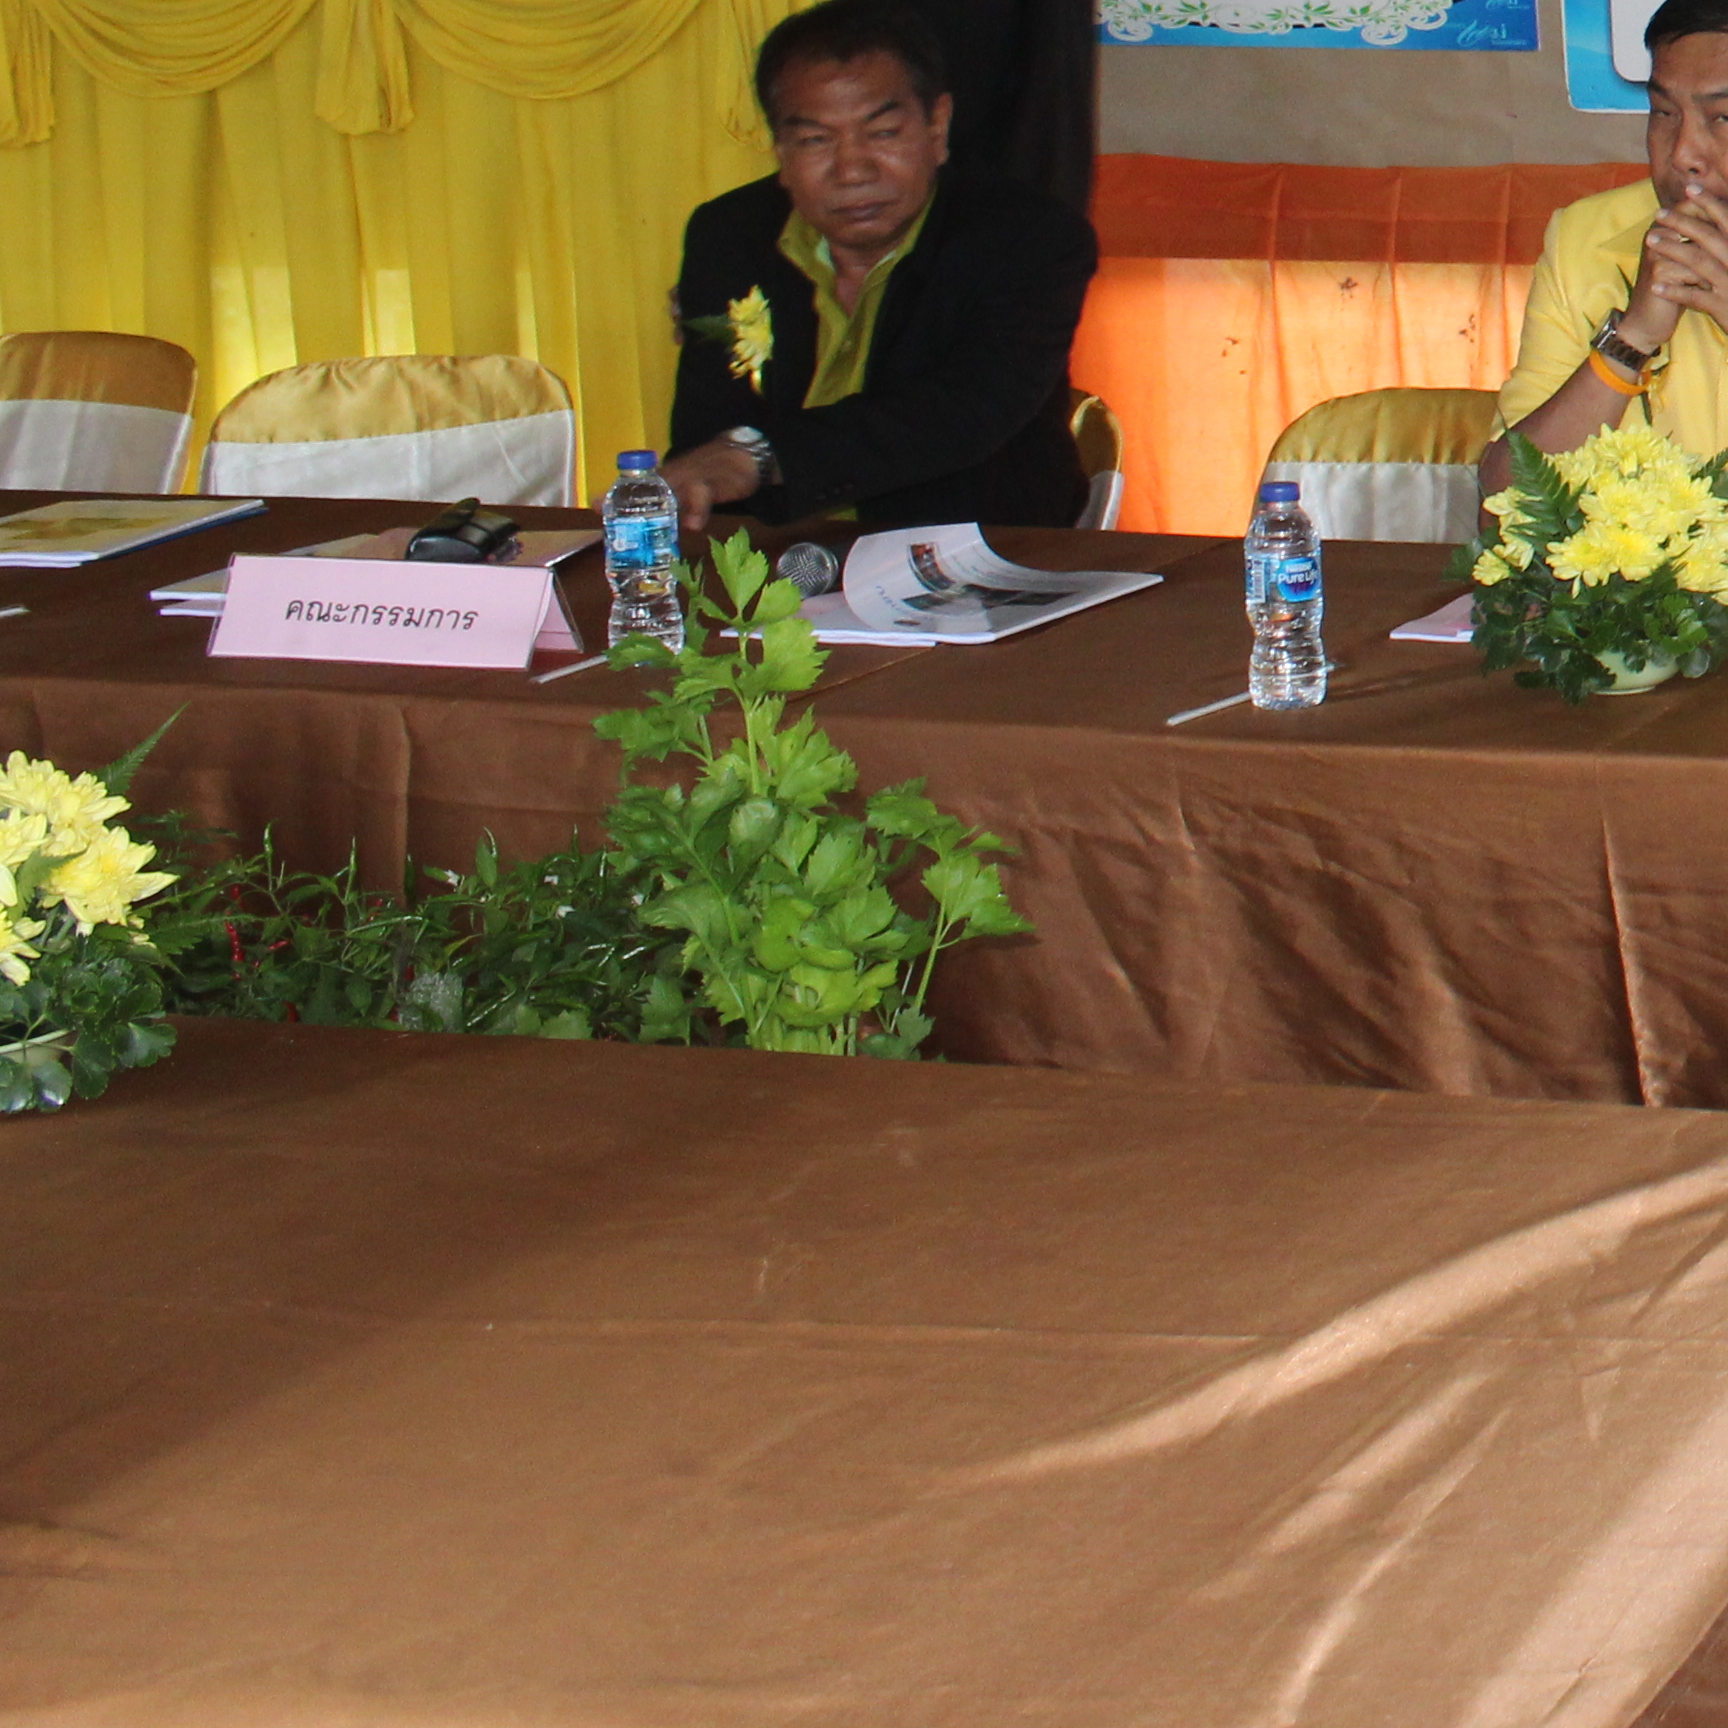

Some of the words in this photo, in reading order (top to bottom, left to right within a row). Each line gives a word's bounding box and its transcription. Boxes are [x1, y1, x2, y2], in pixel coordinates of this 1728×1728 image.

[1277, 571, 1304, 585] Pure
[286, 597, 479, 632] คณะกรรมการ
